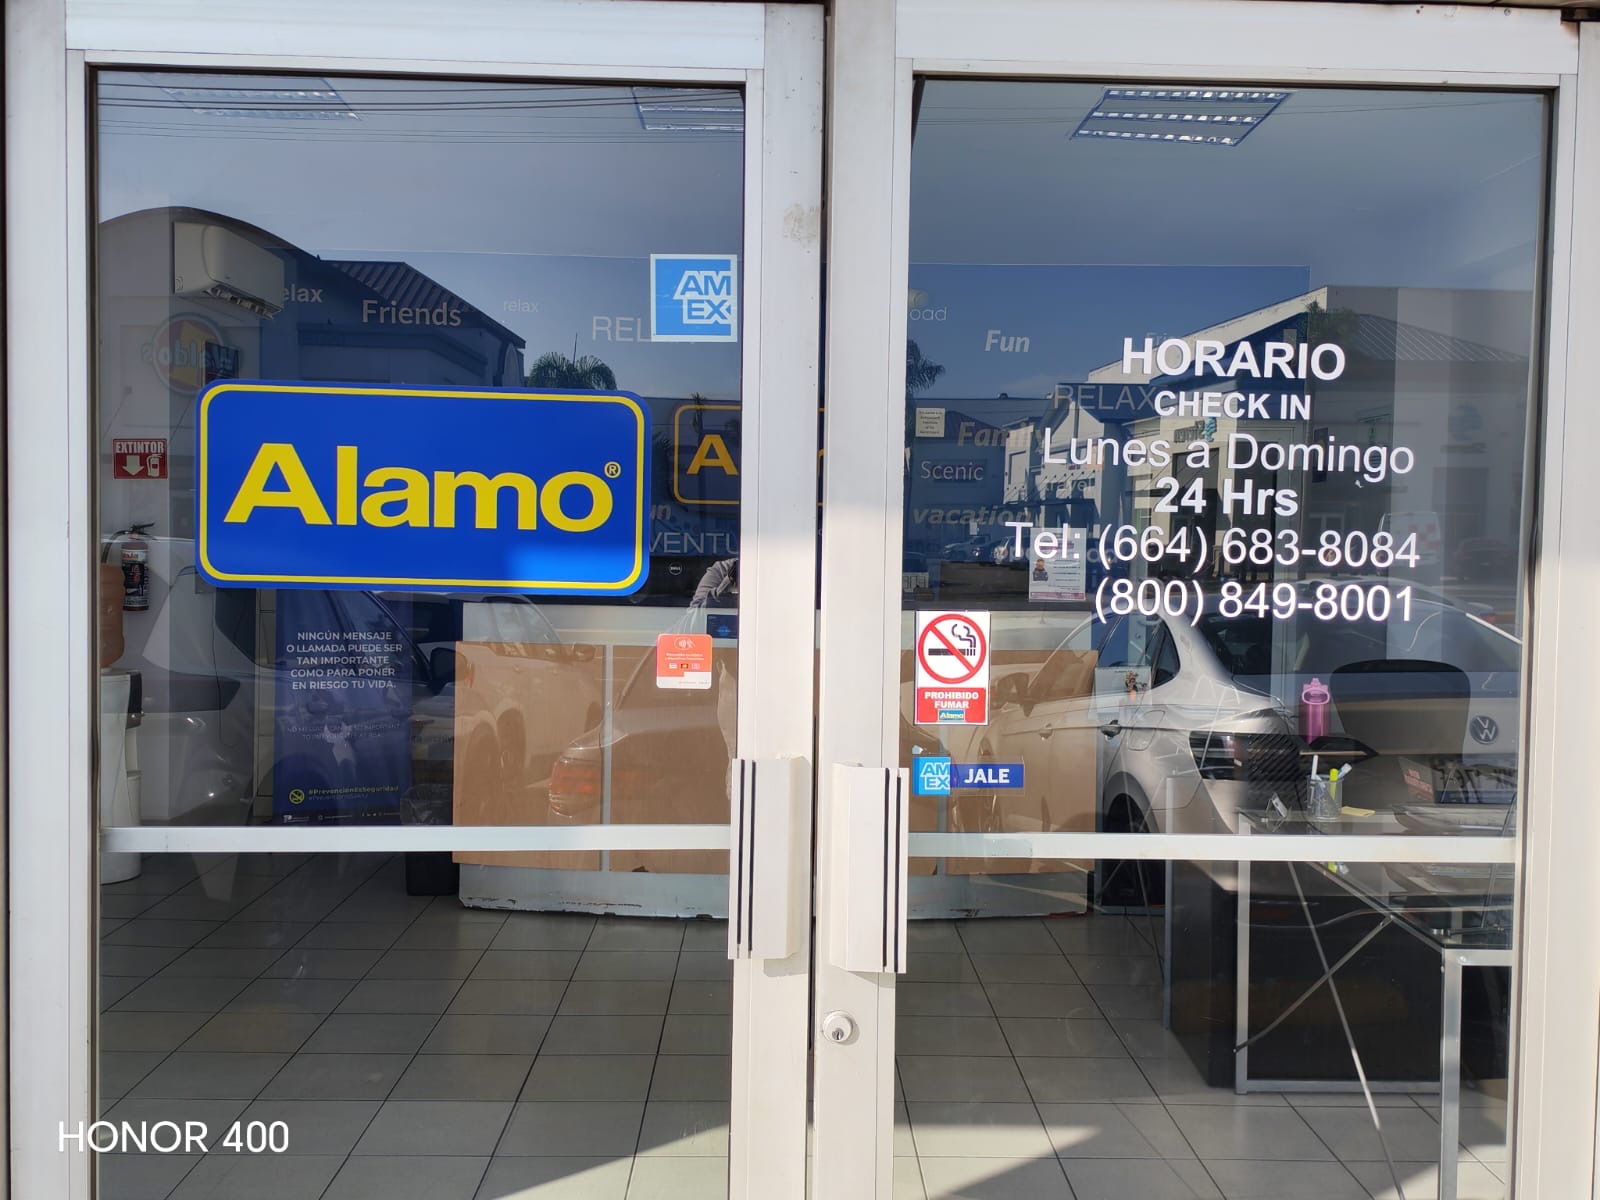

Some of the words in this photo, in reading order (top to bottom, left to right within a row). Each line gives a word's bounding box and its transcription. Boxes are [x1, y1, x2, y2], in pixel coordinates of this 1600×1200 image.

[280, 283, 323, 303] elax
[362, 299, 462, 327] Friends
[503, 299, 539, 313] relax
[909, 306, 948, 322] oad
[984, 329, 1031, 353] Fun
[1121, 336, 1347, 381] HORARIO
[1054, 384, 1157, 410] RELAX
[1154, 389, 1271, 420] CHECK
[1279, 393, 1312, 421] IN
[115, 441, 165, 454] EXTINTOR
[1043, 427, 1171, 468] Lunes
[1185, 441, 1211, 469] a
[1227, 433, 1416, 483] Domingo
[920, 460, 985, 482] Scenic
[1153, 477, 1207, 515] 24
[1222, 478, 1300, 517] Hrs
[1004, 521, 1081, 560] Tel:
[1098, 523, 1208, 573] (664)
[1222, 528, 1421, 569] 683-8084
[1094, 576, 1205, 626] (800)
[1219, 581, 1412, 622] 849-8001
[297, 630, 340, 641] NINGÚN
[343, 631, 392, 641] MENSAJE
[286, 644, 295, 653] O
[296, 644, 346, 653] LLAMADA
[348, 643, 382, 653] PUEDE
[383, 643, 403, 652] SER
[296, 656, 318, 665] TAN
[321, 656, 390, 665] IMPORTANTE
[290, 669, 324, 678] COMO
[326, 668, 356, 677] PARA
[358, 667, 396, 677] PONER
[292, 681, 307, 690] EN
[309, 680, 349, 690] RIESGO
[352, 680, 365, 689] TU
[368, 680, 397, 689] VIDA.
[924, 691, 979, 700] PROHIBIDO
[934, 700, 969, 709] FUMAR
[963, 768, 1010, 784] JALE
